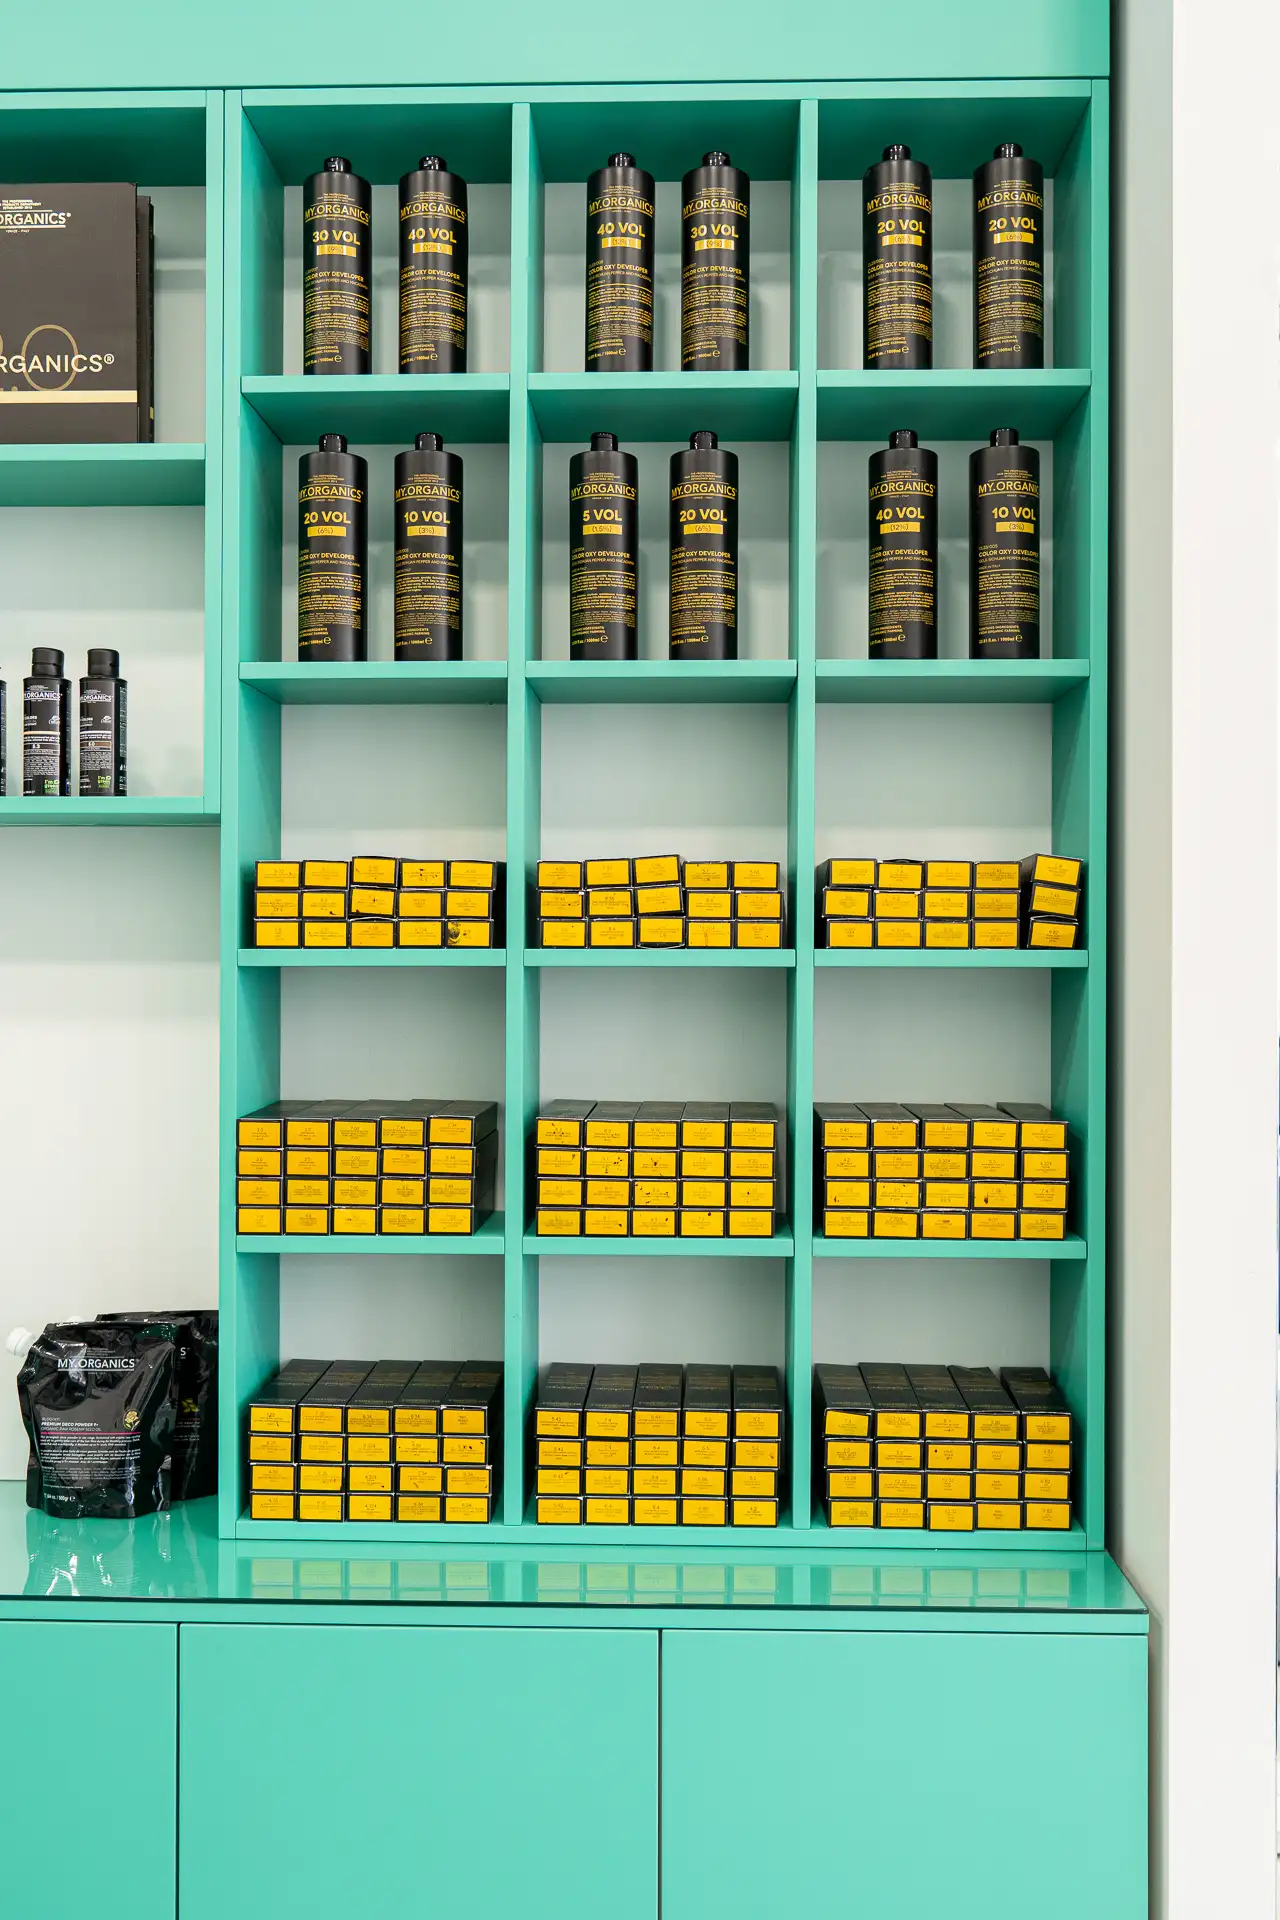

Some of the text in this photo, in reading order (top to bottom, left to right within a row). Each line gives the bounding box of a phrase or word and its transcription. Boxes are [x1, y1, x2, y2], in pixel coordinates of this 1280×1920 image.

[597, 221, 645, 237] 40 VOL
[691, 224, 738, 238] 30 VOL
[878, 219, 926, 234] 20 VOL
[989, 217, 1037, 232] 20 VOL
[313, 230, 360, 245] 30 VOL
[408, 228, 456, 243] 40 VOL
[617, 264, 648, 274] DEVELOPER
[898, 261, 928, 271] DEVELOPER
[1010, 259, 1040, 268] DEVELOPER
[332, 271, 364, 282] DEVELOPER
[428, 269, 460, 280] DEVELOPER
[710, 266, 742, 275] DEVELOPER
[304, 511, 351, 524] 20 VOL
[404, 511, 450, 524] 10 VOL
[583, 509, 622, 522] 5 VOL
[680, 509, 727, 522] 20 VOL
[876, 506, 924, 521] 40 VOL
[992, 506, 1036, 521] 10 VOL
[321, 552, 354, 560] DEVELOPER
[422, 552, 454, 561] DEVELOPER
